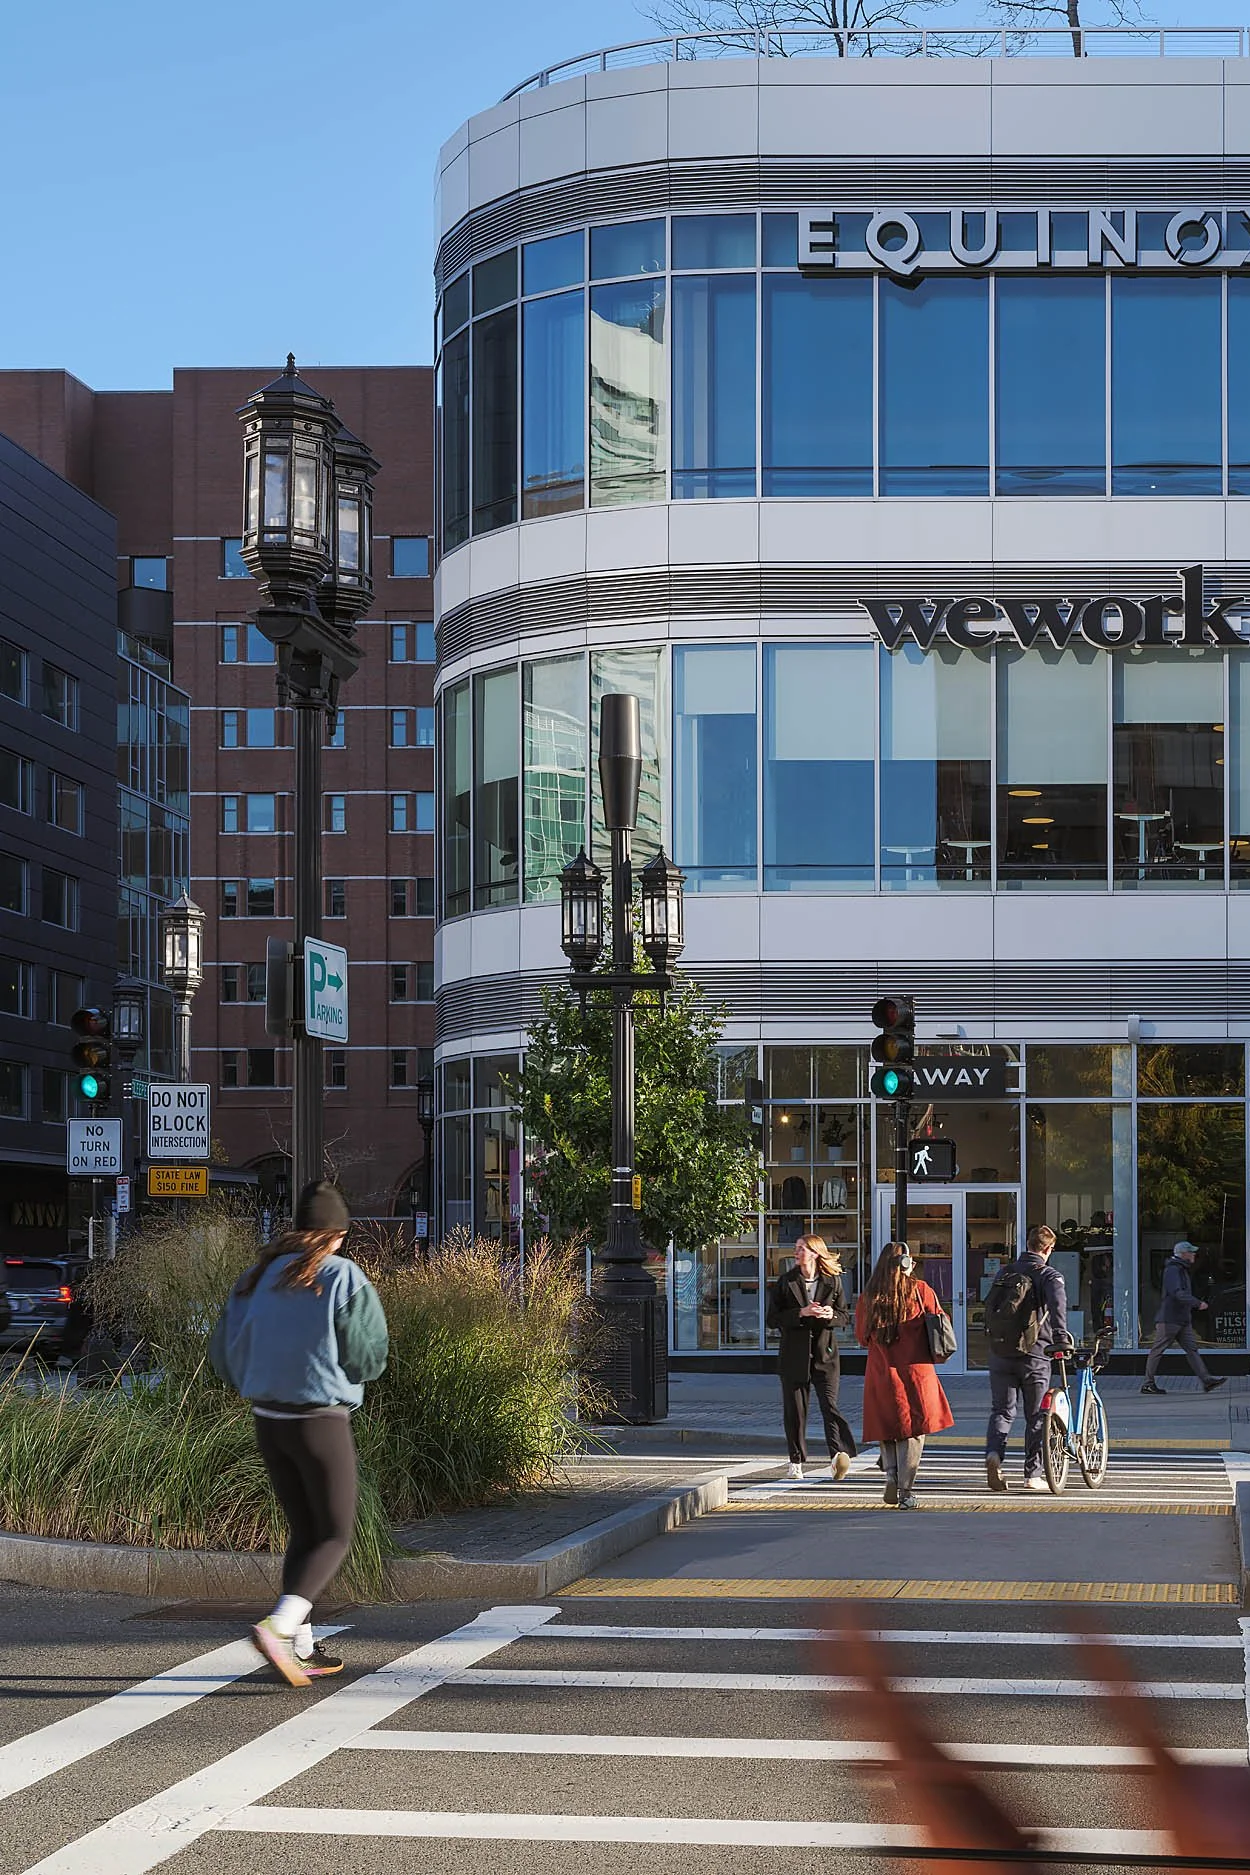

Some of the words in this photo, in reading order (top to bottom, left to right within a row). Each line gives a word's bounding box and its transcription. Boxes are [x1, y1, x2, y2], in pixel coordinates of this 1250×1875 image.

[857, 564, 1250, 648] wework
[152, 1092, 172, 1107] DO
[177, 1092, 206, 1107] NOT
[152, 1115, 206, 1131] BLOCK
[86, 1126, 104, 1136] NO
[81, 1141, 110, 1151] TURN
[152, 1137, 207, 1148] INTERSECTION
[72, 1156, 88, 1167] ON
[95, 1156, 117, 1167] RED
[156, 1171, 179, 1180] STATE
[184, 1171, 200, 1180] LAW
[157, 1182, 176, 1192] $150
[181, 1182, 199, 1191] FINE
